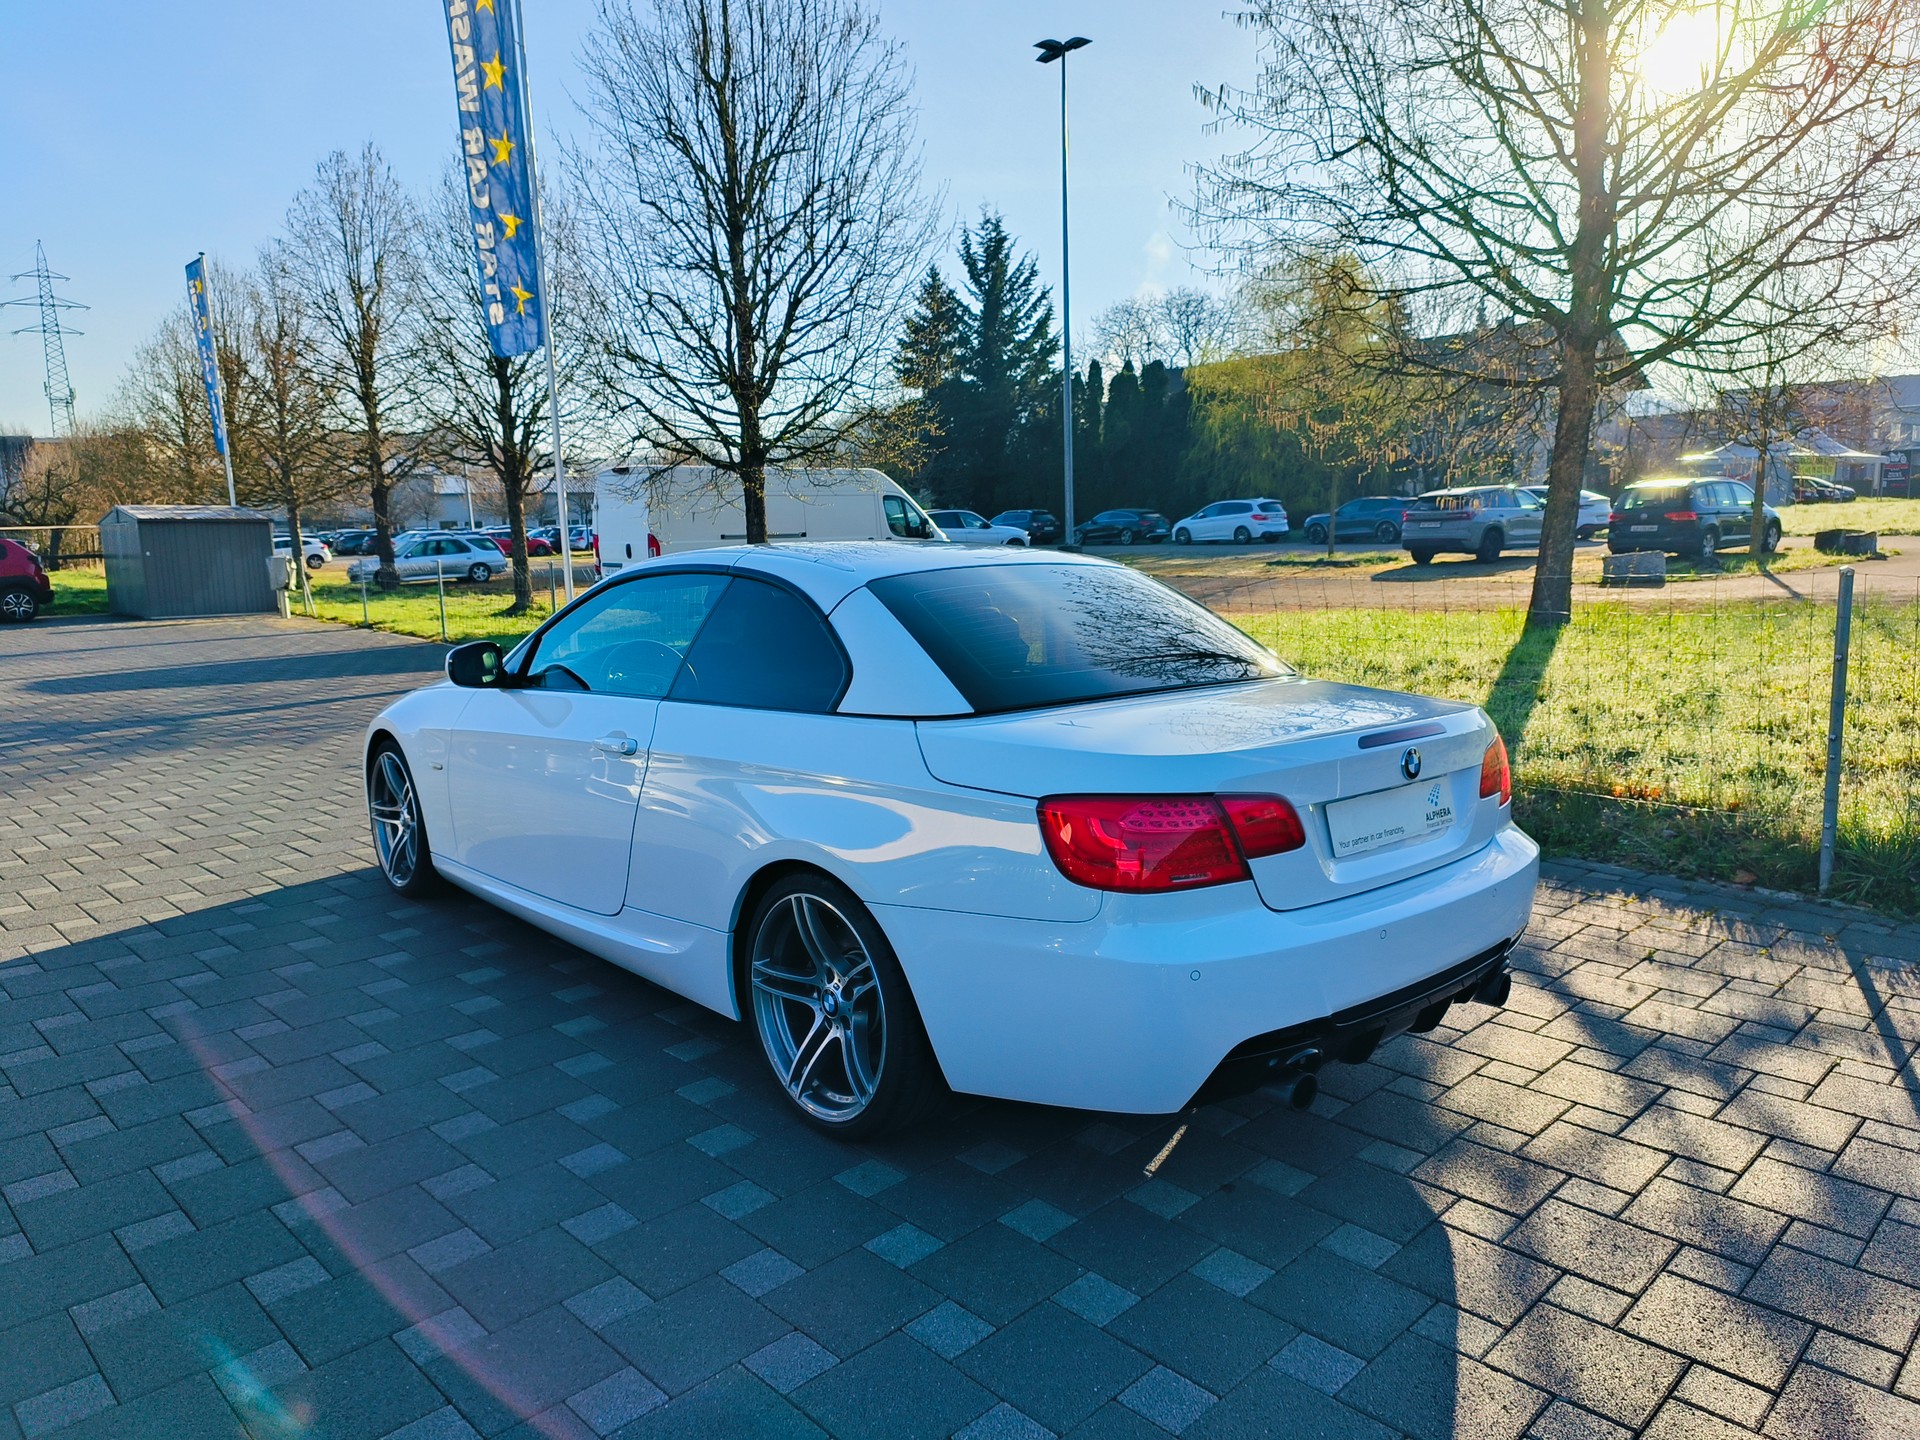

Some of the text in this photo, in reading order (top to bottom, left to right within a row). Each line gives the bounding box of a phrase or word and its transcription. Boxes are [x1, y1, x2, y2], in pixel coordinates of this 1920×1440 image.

[1425, 807, 1452, 822] ALPHERA
[1339, 840, 1351, 849] Your
[1351, 835, 1369, 848] partner
[1375, 831, 1384, 840] car
